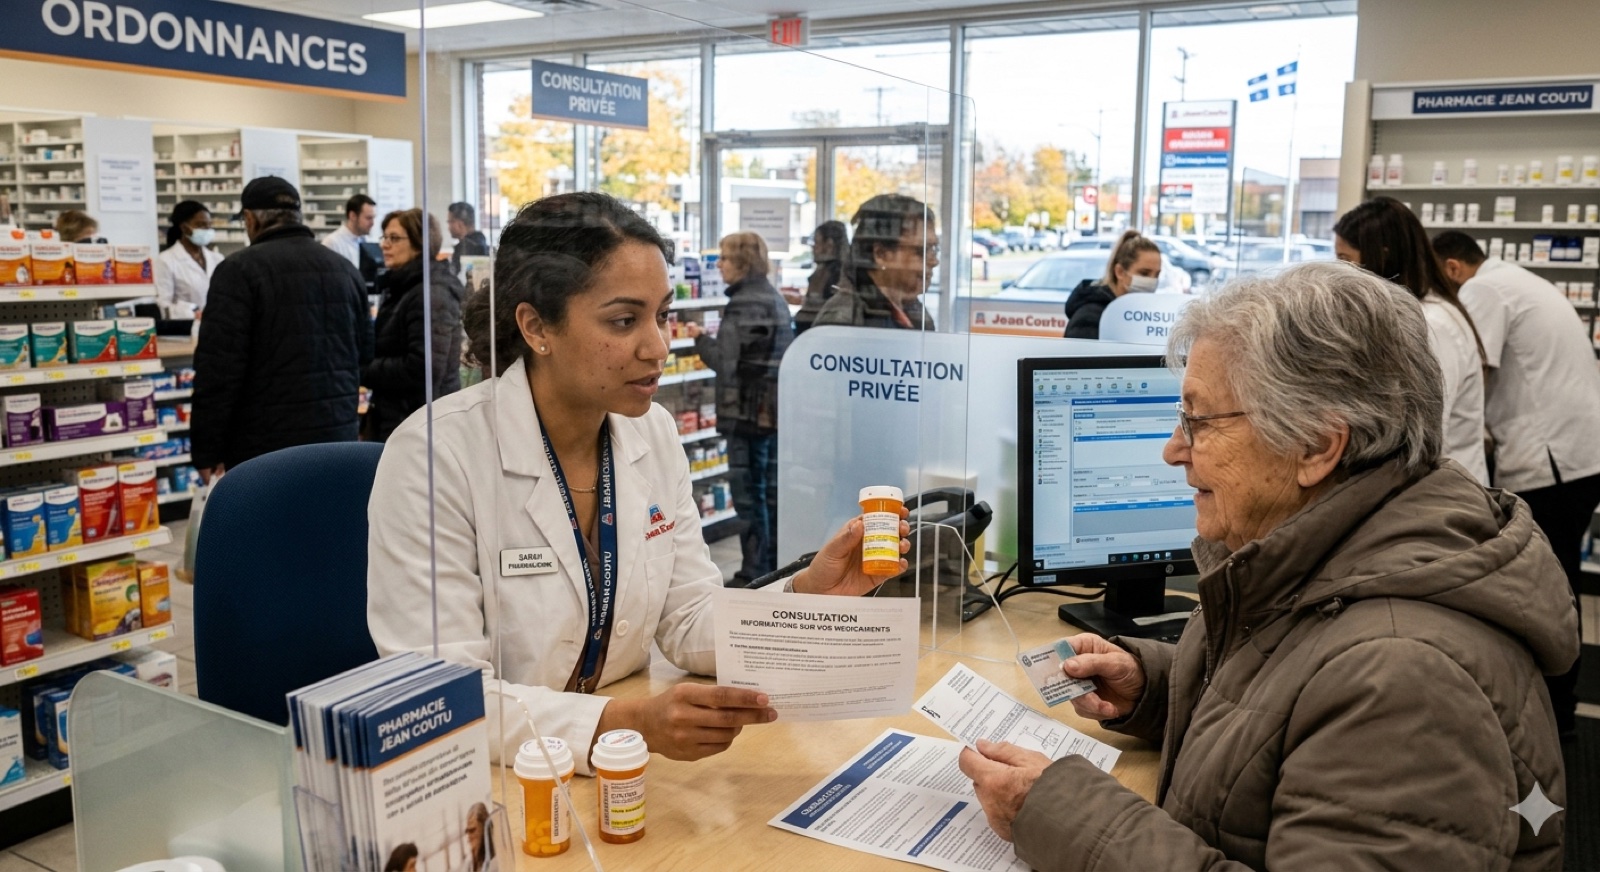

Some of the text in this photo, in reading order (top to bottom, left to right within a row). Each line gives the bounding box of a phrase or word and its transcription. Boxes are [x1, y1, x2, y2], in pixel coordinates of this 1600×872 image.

[41, 0, 367, 76] ORDONNANCES
[541, 71, 642, 101] CONSULTATION
[1417, 91, 1589, 109] PHARMACIE JEAN COUTU
[569, 96, 616, 116] PRIVÉE
[810, 353, 963, 381] CONSULTATION
[849, 379, 919, 402] PRIVÉE
[773, 610, 858, 623] CONSULTATION
[378, 697, 445, 738] PHARMACIE
[380, 710, 452, 753] JEAN COUTU
